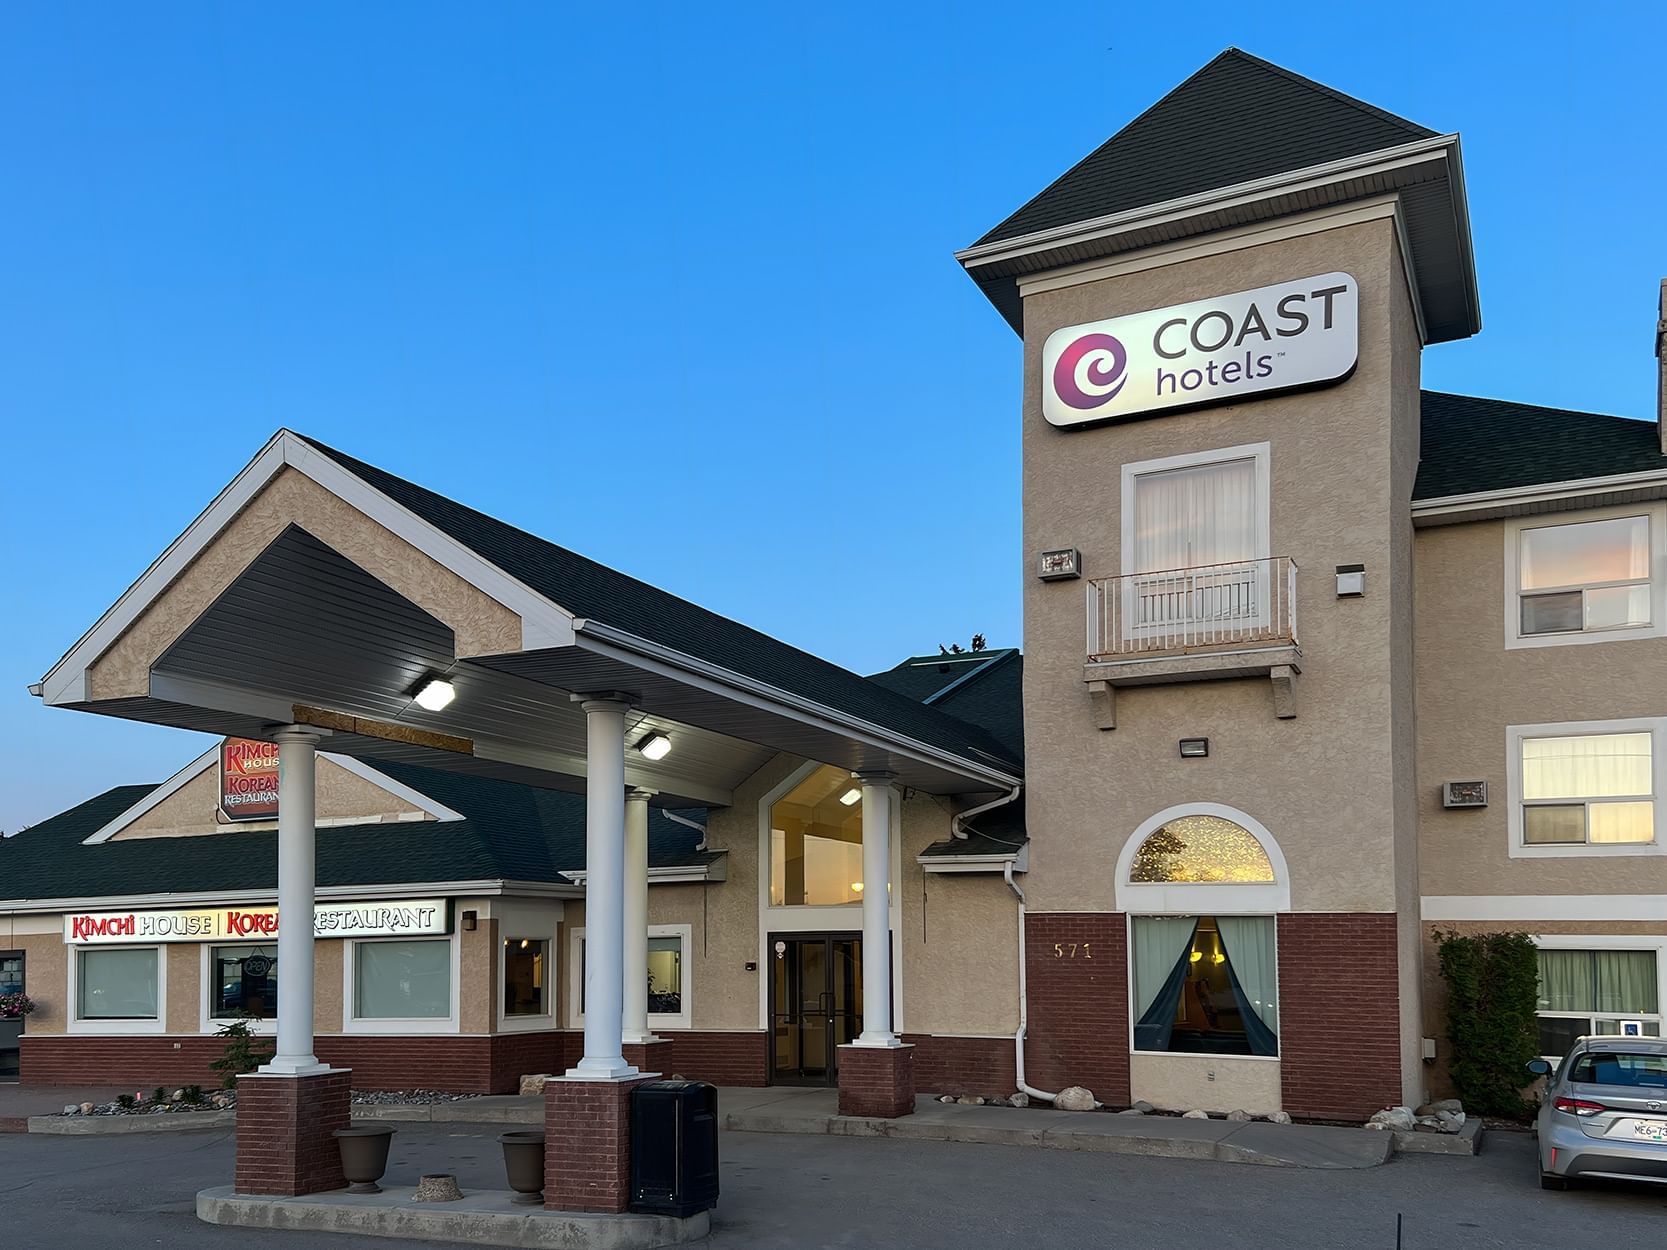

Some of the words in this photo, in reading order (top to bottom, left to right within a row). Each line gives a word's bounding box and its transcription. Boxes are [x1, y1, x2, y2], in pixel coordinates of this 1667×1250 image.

[1153, 285, 1347, 359] COAST
[1156, 351, 1273, 395] hotels
[225, 742, 279, 774] KIMCH
[243, 758, 279, 768] HOUS
[224, 791, 279, 807] RESTAURAN
[139, 915, 211, 935] HOUSE
[227, 911, 279, 936] KORE
[314, 907, 435, 934] ESTAURANT
[1054, 943, 1091, 958] 571
